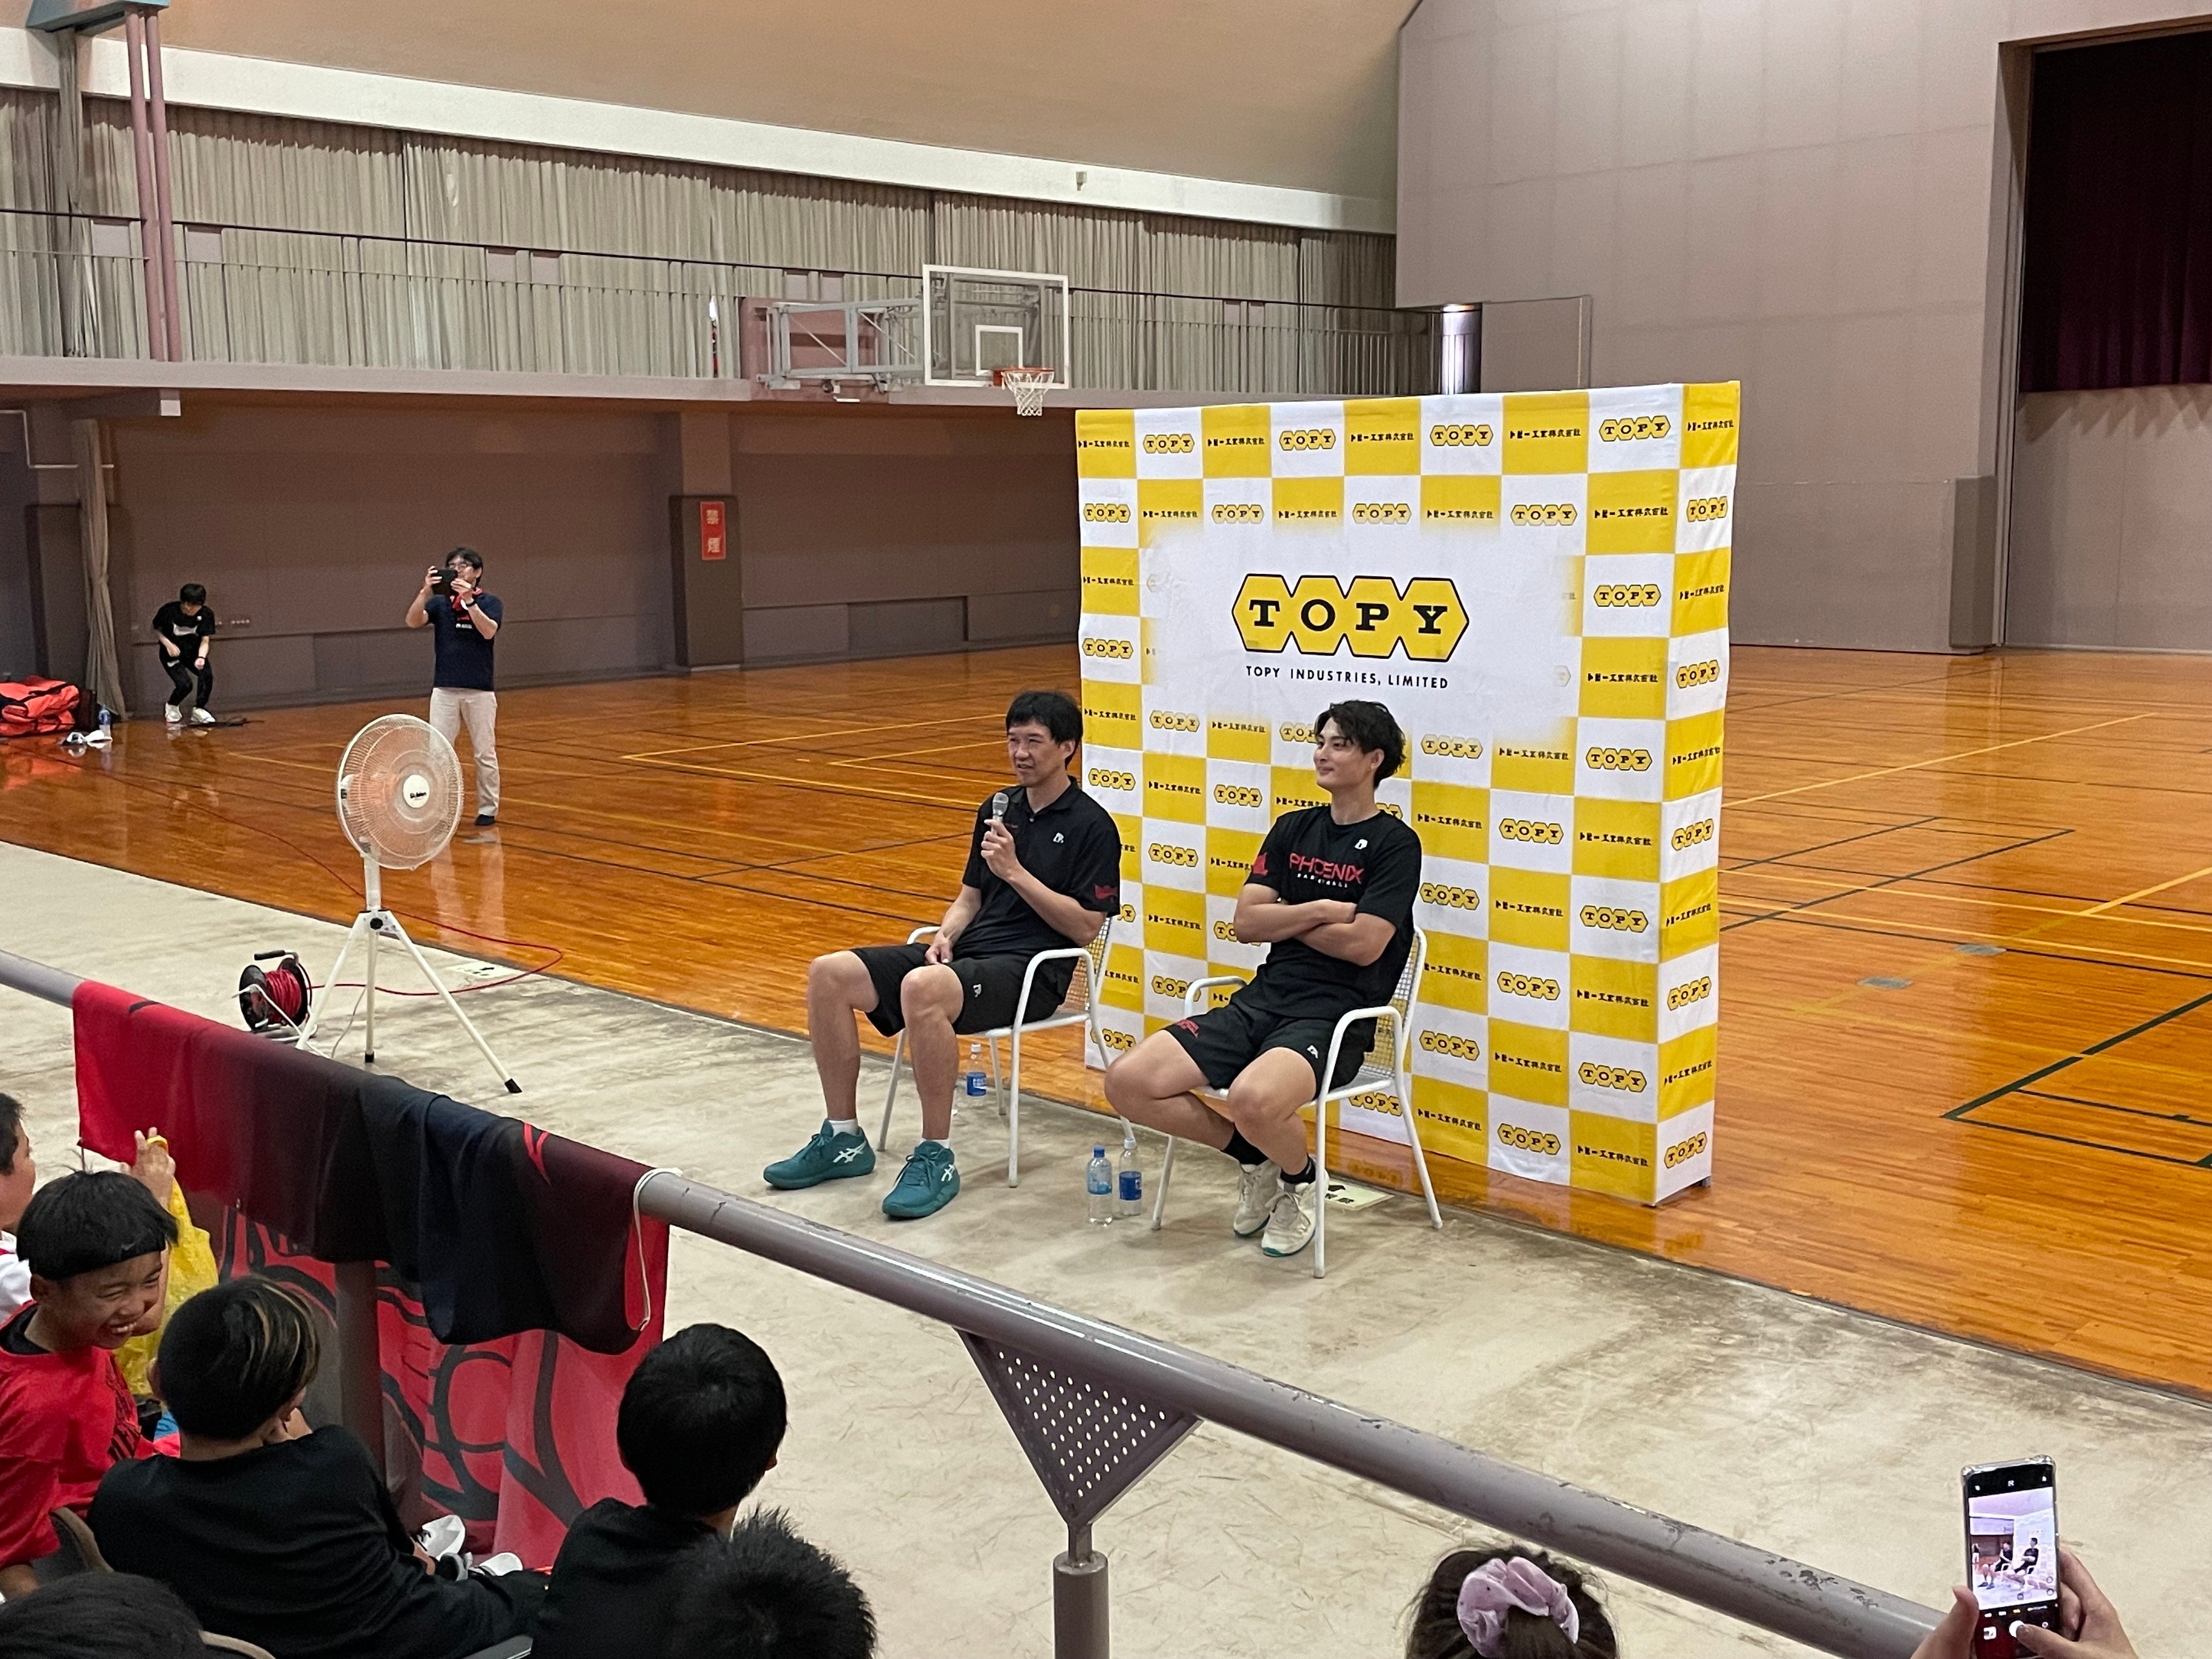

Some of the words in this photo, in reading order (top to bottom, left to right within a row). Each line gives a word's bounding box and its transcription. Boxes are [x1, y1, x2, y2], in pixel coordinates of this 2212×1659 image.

[1605, 422, 1665, 434] TOPY
[1690, 503, 1725, 515] TOPY
[1249, 599, 1447, 634] TOPY
[1246, 666, 1279, 678] TOPY
[1291, 669, 1380, 685] INDUSTRIES,
[1389, 675, 1447, 688] LIMITED
[1679, 666, 1717, 682] TOPY
[1426, 741, 1477, 752] TOPY
[1092, 774, 1131, 785] TOPY
[1218, 791, 1258, 802] TOPY
[1505, 825, 1559, 838] TOPY
[1676, 825, 1711, 844] TOPY
[1153, 849, 1194, 861] TOPY
[1289, 852, 1364, 884] PHOENIX
[1424, 889, 1475, 904] TOPY
[1585, 912, 1641, 926] TOPY
[1502, 978, 1555, 994] TOPY
[1670, 982, 1709, 1004] TOPY
[1424, 1037, 1475, 1054] TOPY
[1584, 1069, 1641, 1086] TOPY
[1503, 1130, 1555, 1149] TOPY
[1668, 1138, 1705, 1161] TOPY
